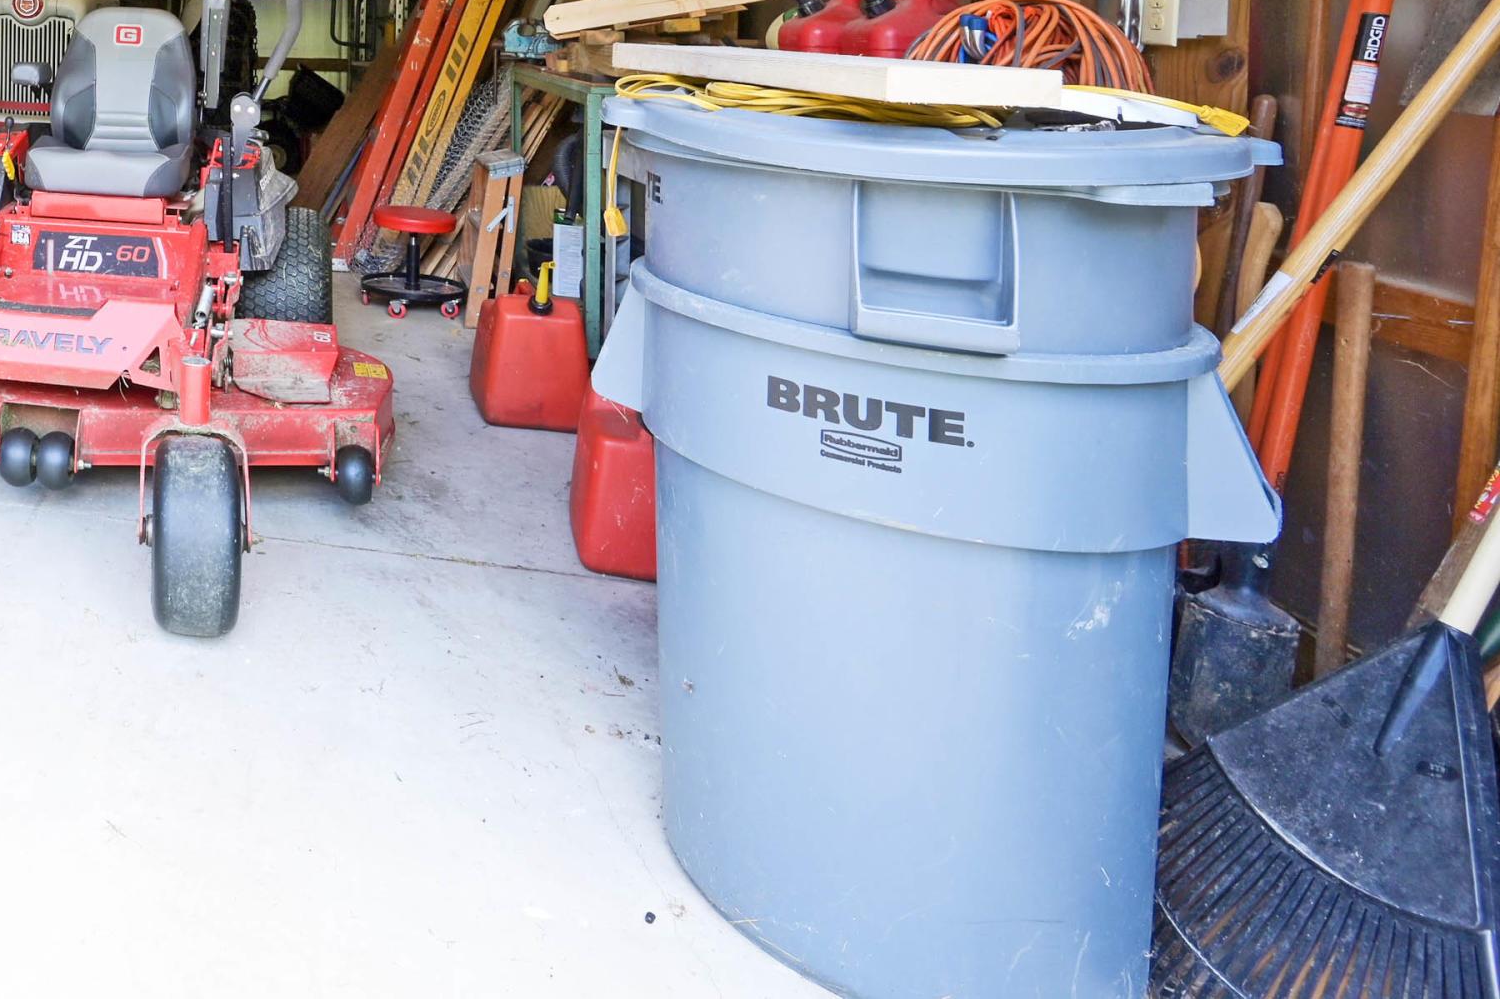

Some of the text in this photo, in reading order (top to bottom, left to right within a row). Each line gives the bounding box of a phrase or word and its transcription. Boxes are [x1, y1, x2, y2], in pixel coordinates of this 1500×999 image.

[1363, 15, 1386, 61] RIDGID
[65, 235, 98, 250] ZT
[766, 375, 965, 447] BRUTE
[823, 433, 900, 458] Rubbermaid
[820, 449, 902, 474] Commercial Products
